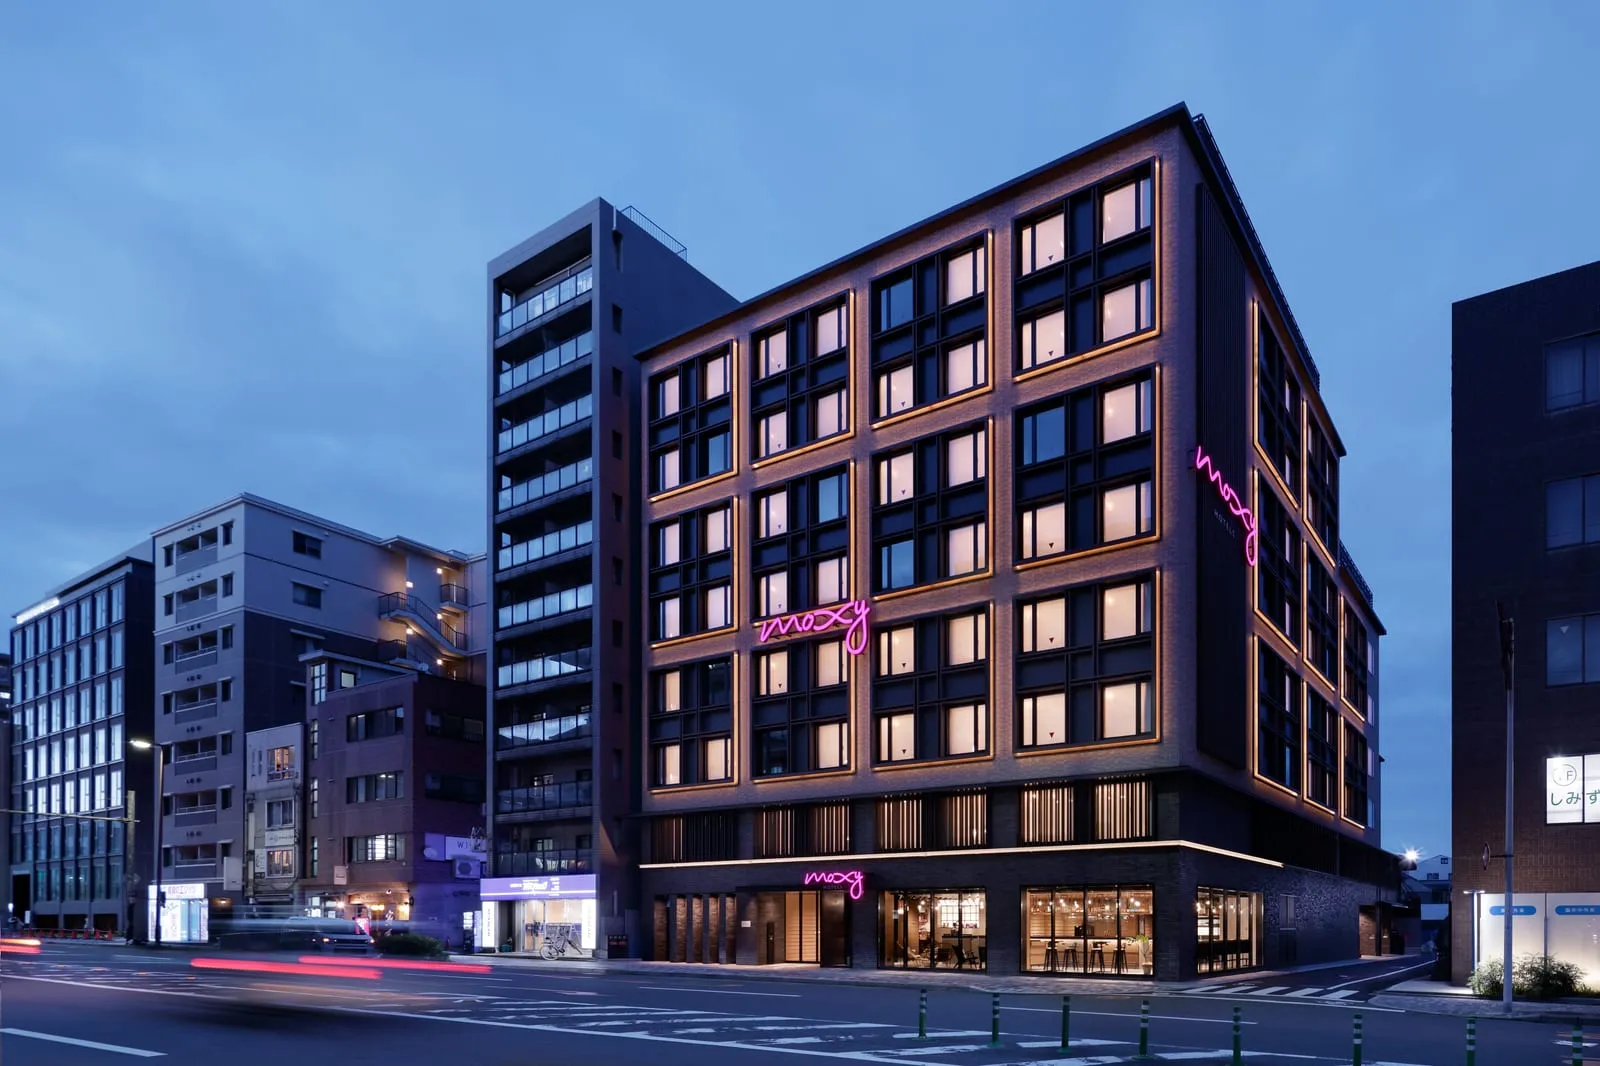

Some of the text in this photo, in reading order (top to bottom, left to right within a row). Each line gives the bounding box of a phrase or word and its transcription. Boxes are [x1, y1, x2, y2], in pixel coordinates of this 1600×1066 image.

[1196, 446, 1257, 566] moxy
[760, 600, 870, 655] moxy
[804, 871, 864, 899] moxy
